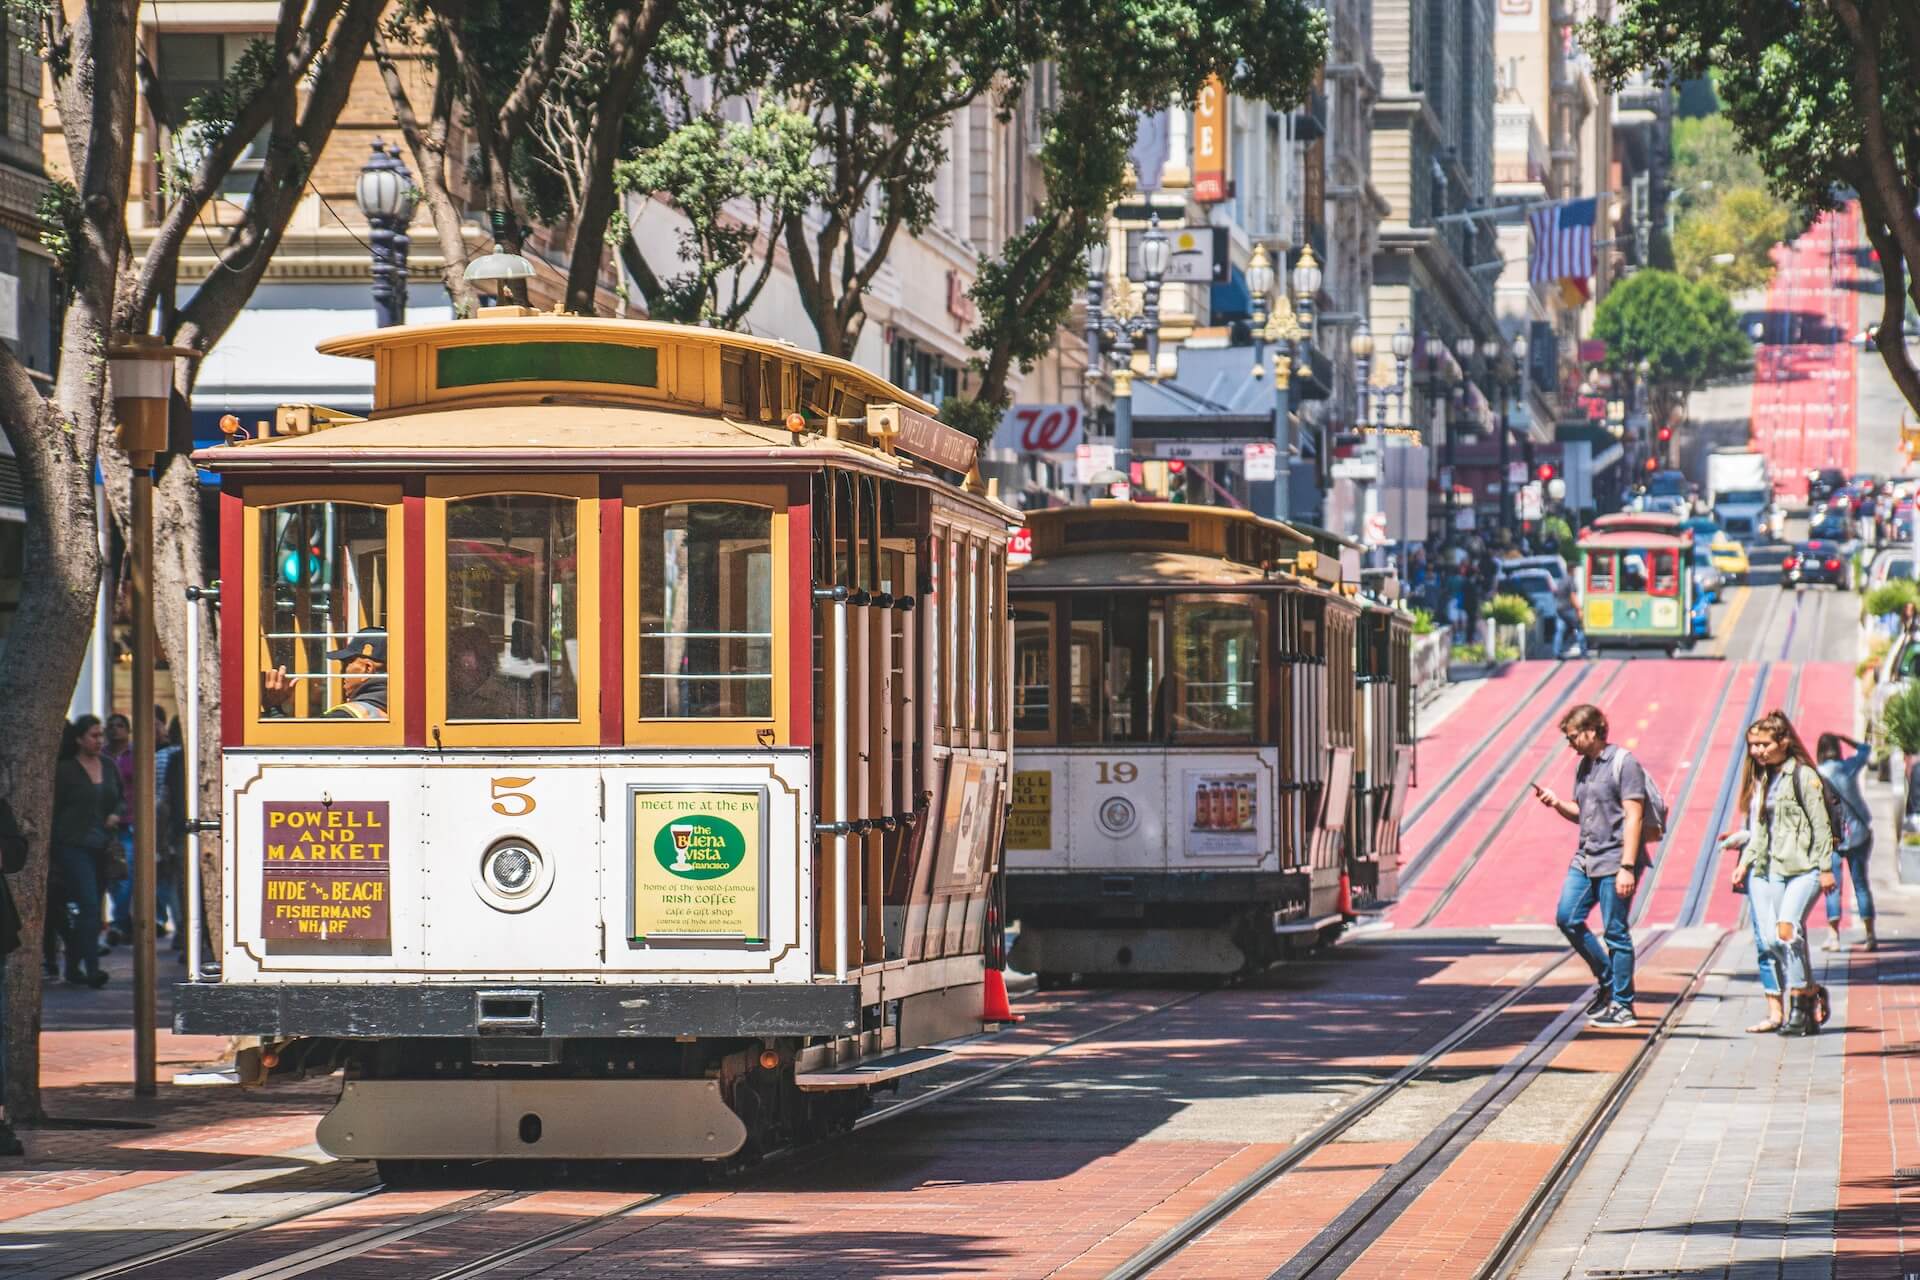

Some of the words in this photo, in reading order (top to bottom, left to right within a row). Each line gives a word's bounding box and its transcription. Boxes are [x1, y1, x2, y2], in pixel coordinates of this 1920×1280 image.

[1096, 761, 1138, 785] 19
[491, 776, 536, 816] 5
[269, 811, 382, 828] POWELL
[299, 830, 355, 843] AND
[267, 844, 385, 861] MARKET
[267, 881, 307, 901] HYDE
[332, 882, 383, 902] BEACH
[275, 904, 373, 919] FISHERMANS
[298, 920, 348, 934] WHARF
